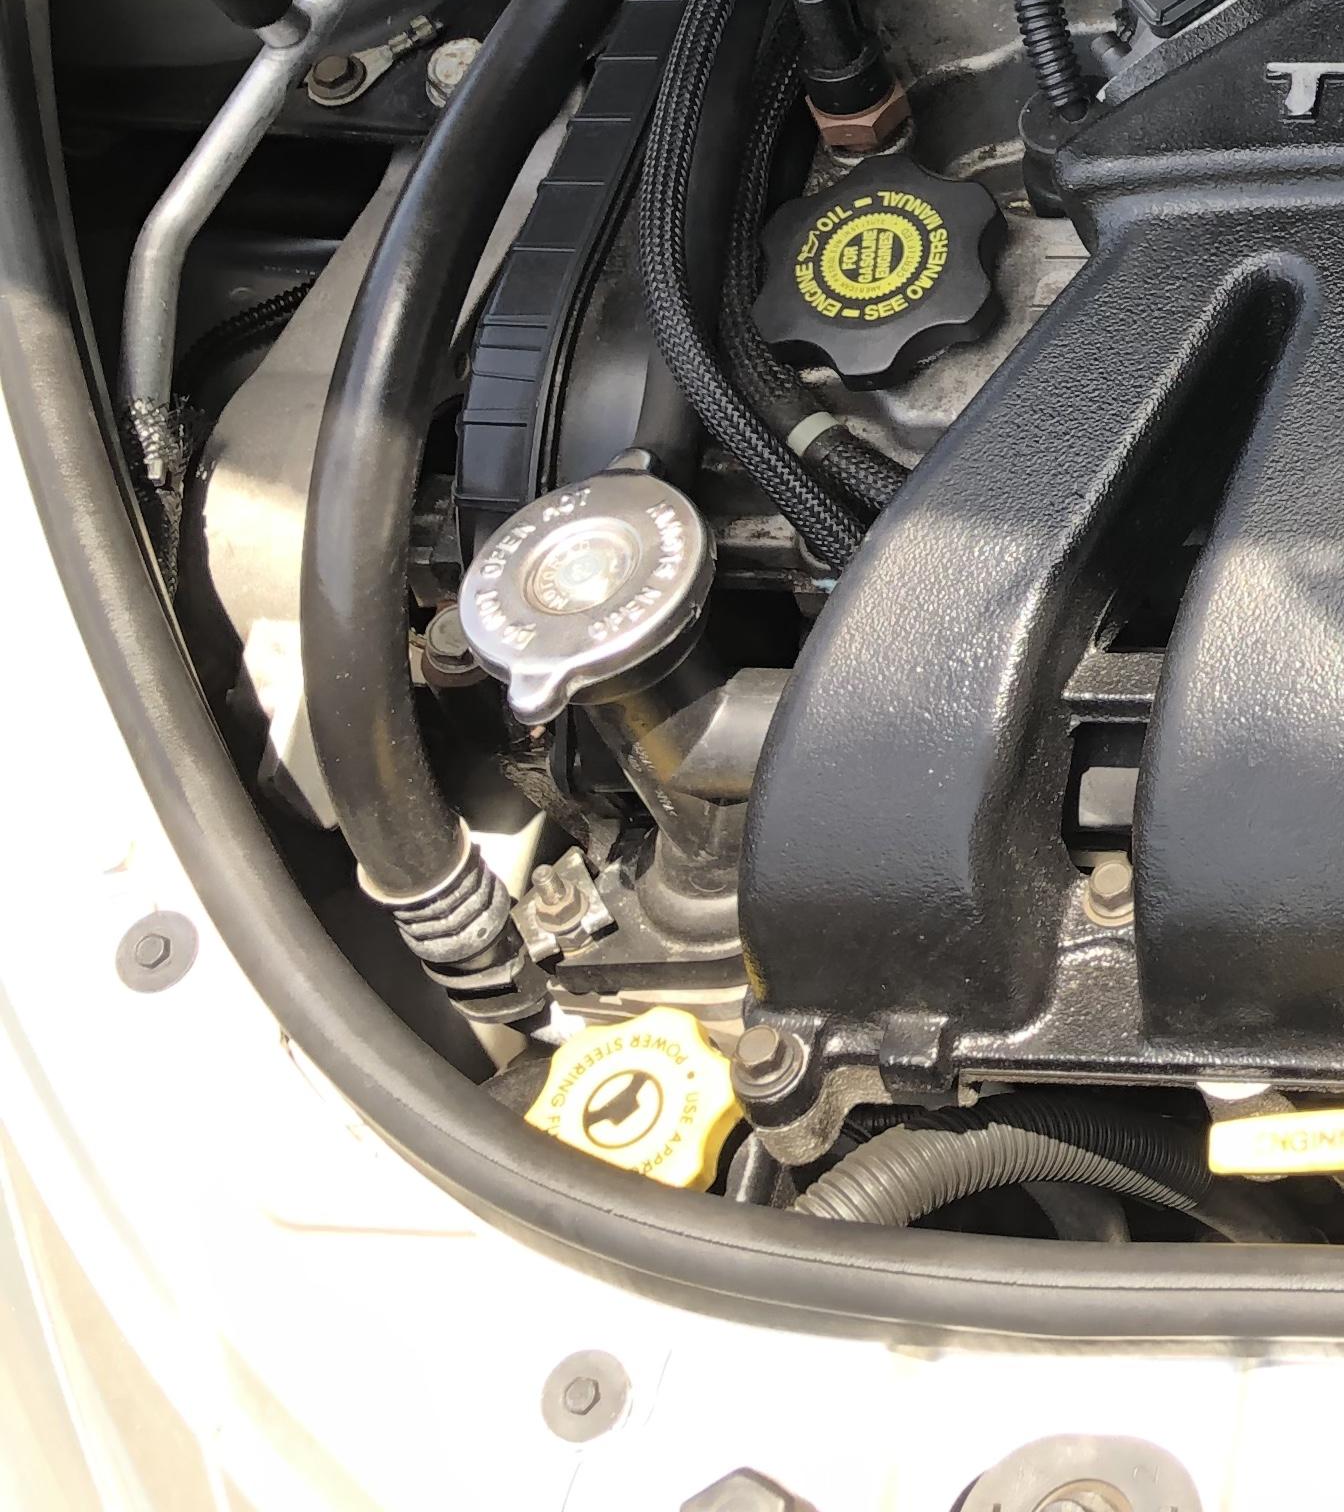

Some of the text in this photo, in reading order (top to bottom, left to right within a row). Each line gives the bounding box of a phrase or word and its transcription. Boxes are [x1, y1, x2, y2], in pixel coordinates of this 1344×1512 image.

[795, 190, 950, 322] ENGINE OIL SEE OWNERS MANUAL
[841, 245, 859, 271] FOR
[857, 228, 879, 284] GASOLINE
[875, 230, 895, 279] ENGINES
[479, 522, 537, 579] OPEN
[551, 1037, 624, 1108] STEERING
[629, 1034, 688, 1065] POWER
[680, 1091, 698, 1125] USE
